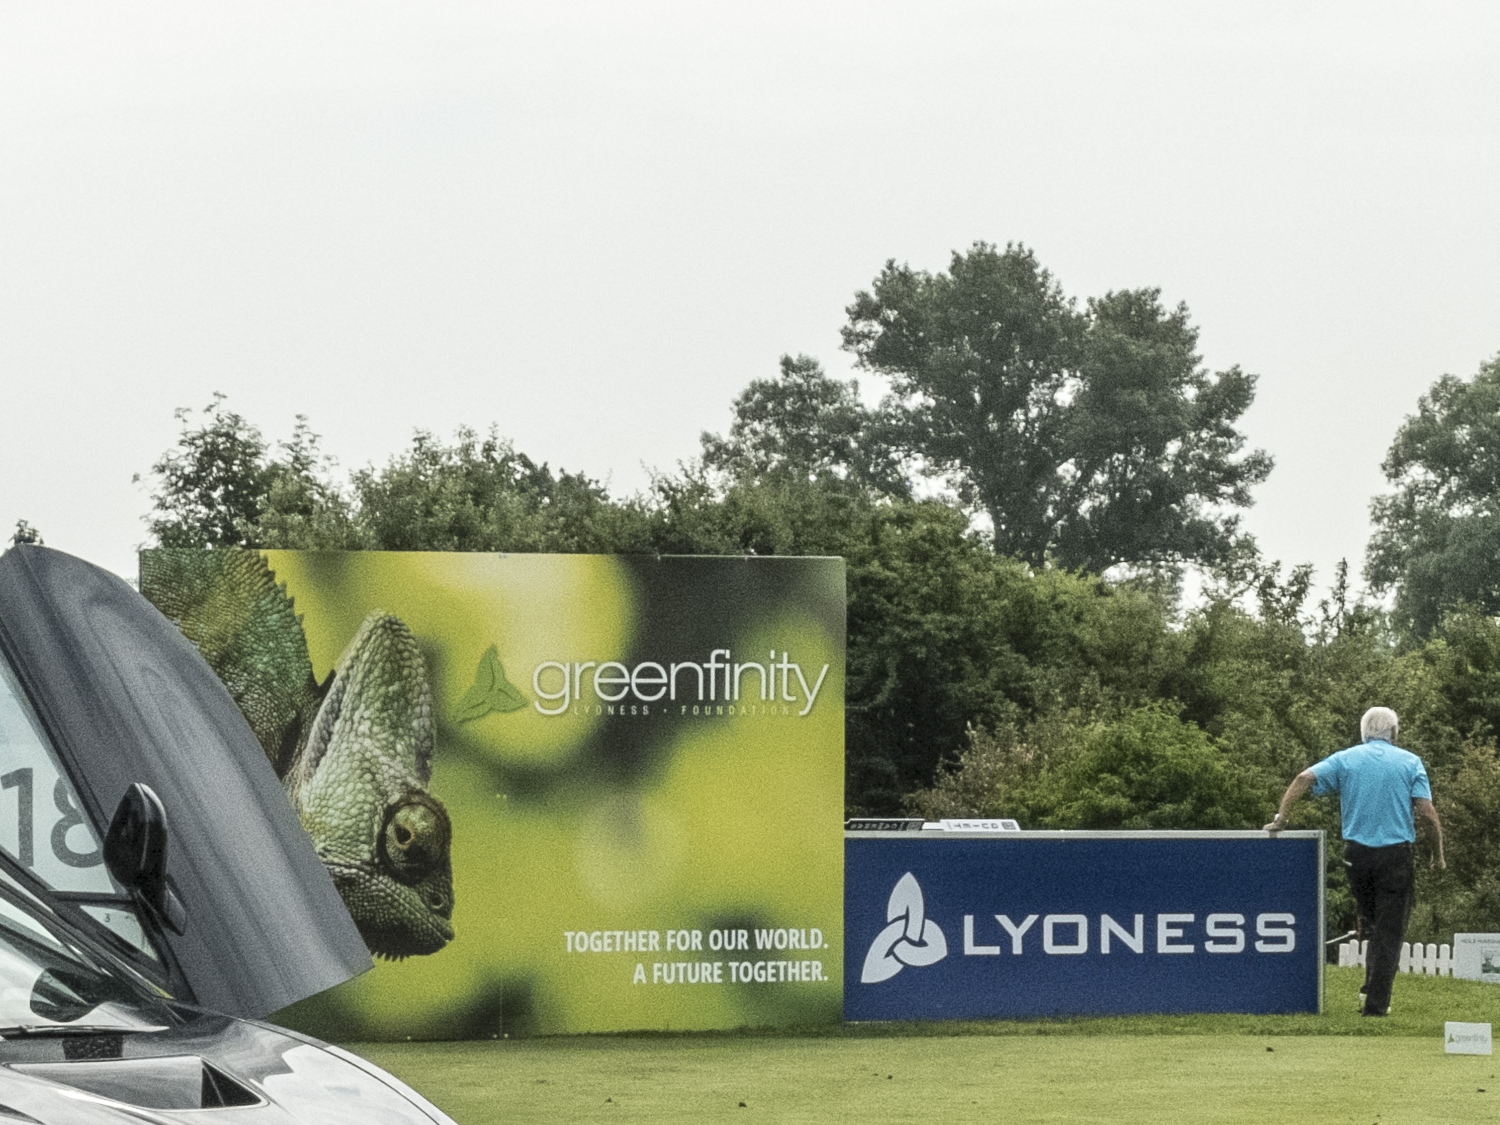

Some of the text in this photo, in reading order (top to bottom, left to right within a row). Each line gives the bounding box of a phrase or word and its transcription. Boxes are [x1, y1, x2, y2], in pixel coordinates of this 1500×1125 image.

[532, 648, 830, 716] greenfinity
[573, 704, 789, 716] LYONESS FOUNDATION
[563, 927, 829, 952] TOGETHER FOR OUR WORLD.
[962, 912, 1297, 956] LYONESS
[632, 960, 829, 984] A FUTURE TOGETHER.
